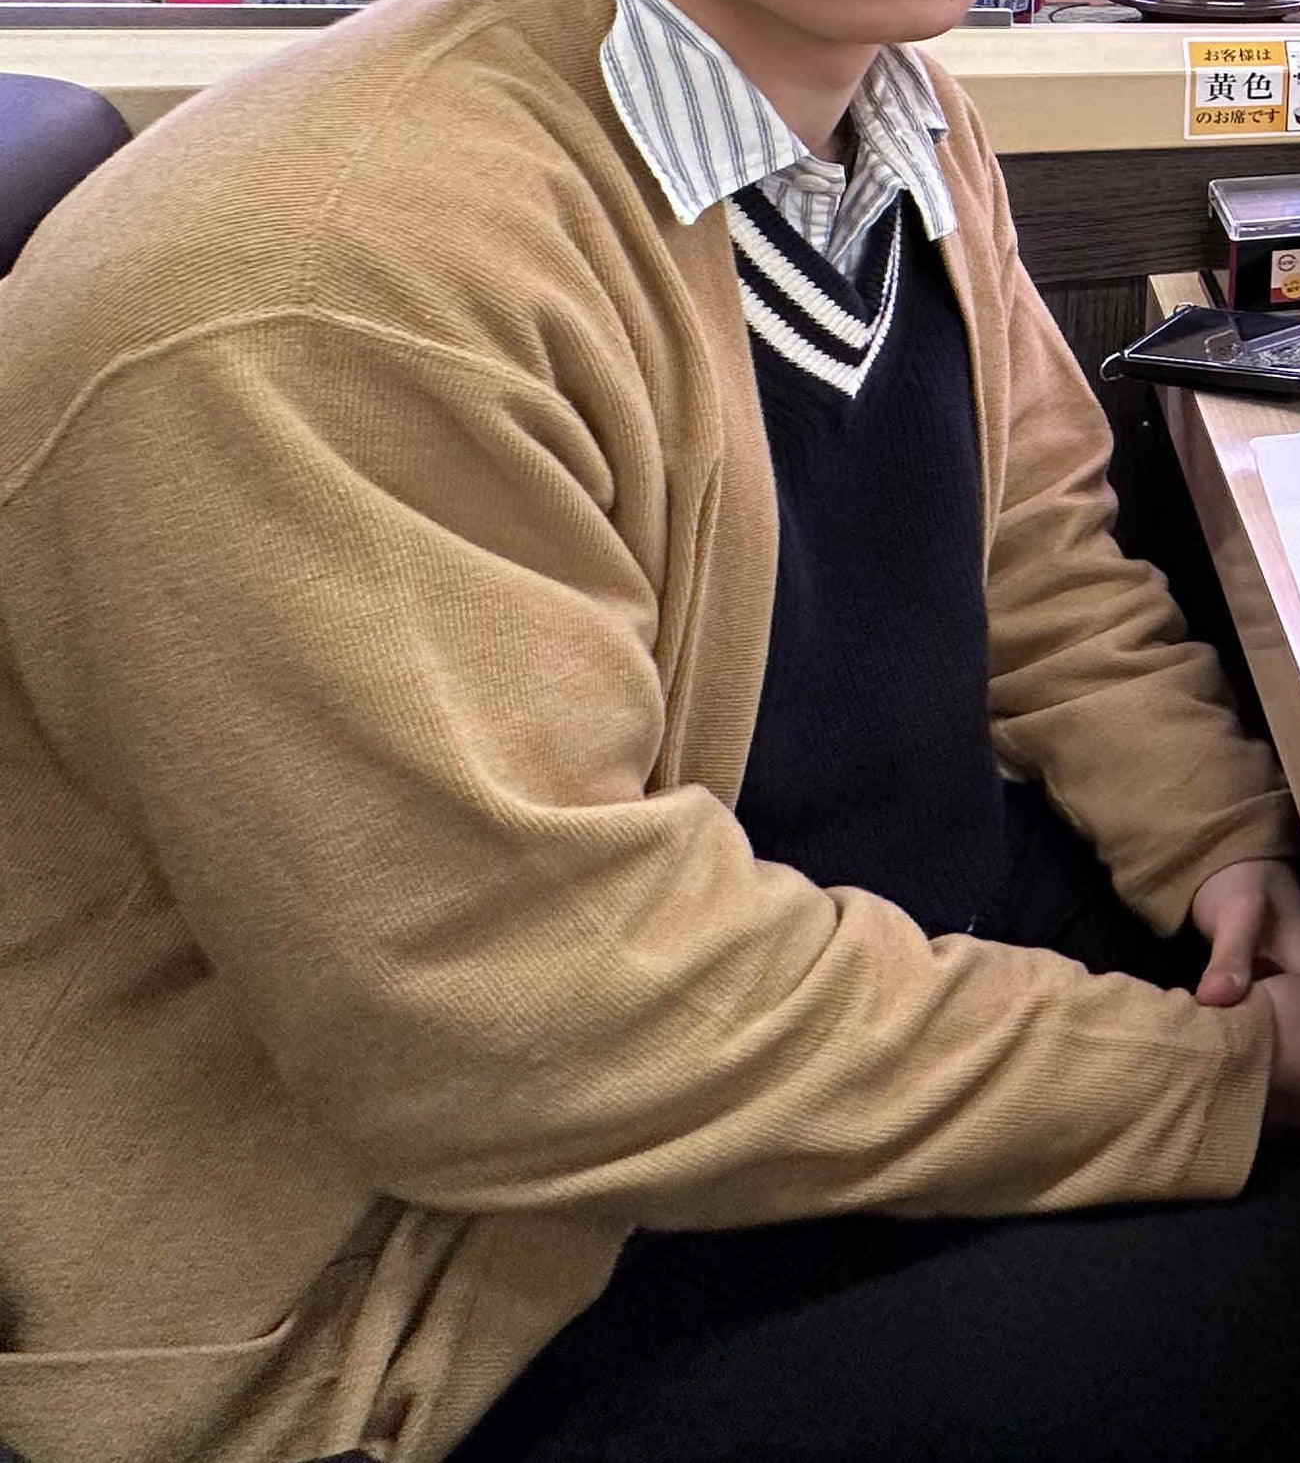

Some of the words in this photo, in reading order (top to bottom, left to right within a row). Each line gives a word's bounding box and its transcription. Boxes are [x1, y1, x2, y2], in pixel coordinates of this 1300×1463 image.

[1203, 46, 1273, 63] お客様は
[1206, 72, 1274, 102] 黄色
[1196, 107, 1281, 125] のお席です
